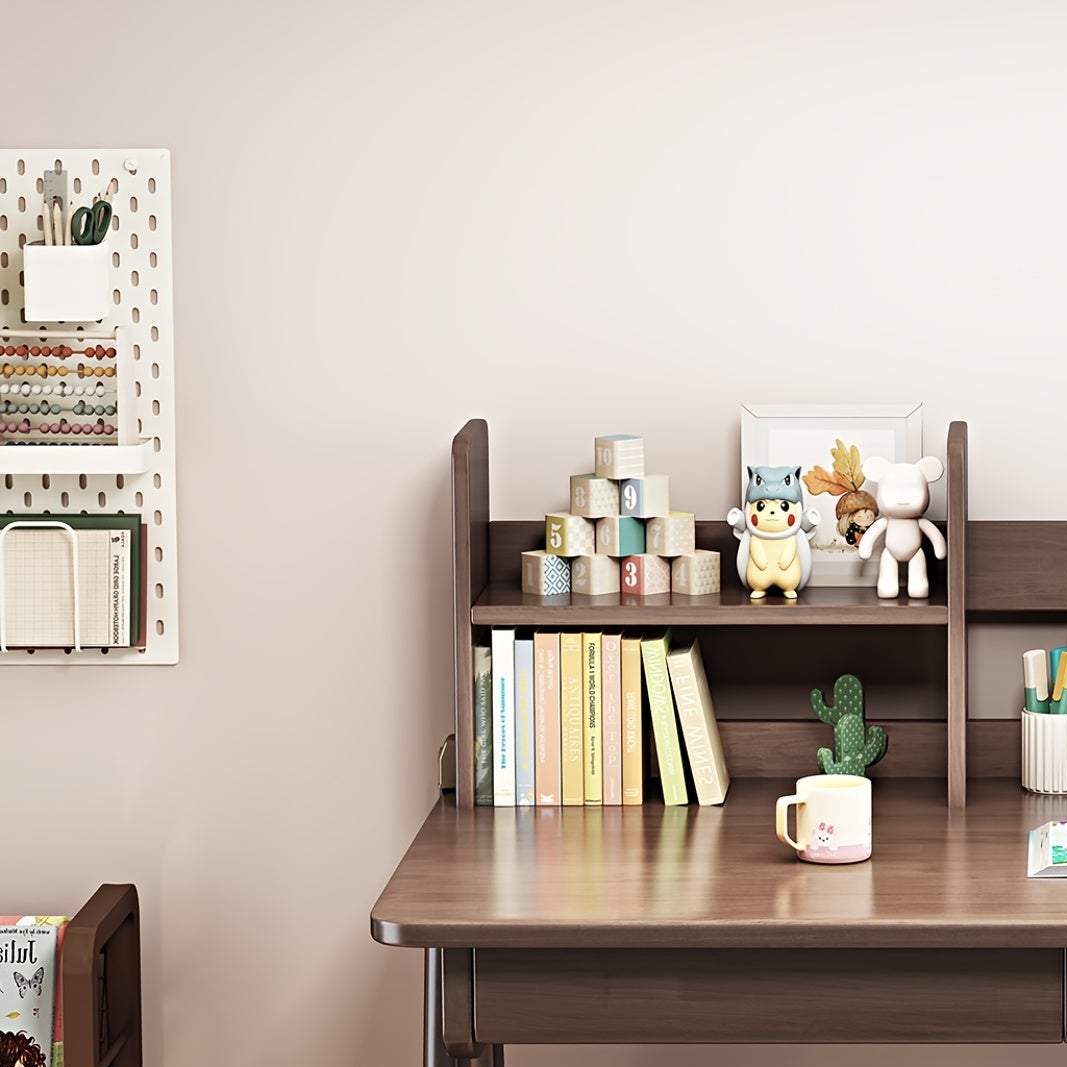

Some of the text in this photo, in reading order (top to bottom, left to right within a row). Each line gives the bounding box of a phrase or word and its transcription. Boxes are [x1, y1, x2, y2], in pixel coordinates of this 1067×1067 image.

[597, 446, 613, 466] 10
[575, 483, 586, 508] 8
[623, 484, 637, 510] 9
[550, 523, 562, 549] 5
[600, 525, 610, 546] 6
[649, 524, 662, 548] 7
[525, 563, 534, 587] 1
[575, 561, 587, 587] 2
[624, 561, 638, 587] 3
[675, 563, 688, 586] 4
[588, 642, 596, 669] FORMULA
[588, 675, 596, 694] WORLD
[568, 677, 581, 762] ANTIQUAIRES
[588, 695, 596, 729] CHAMPIONS
